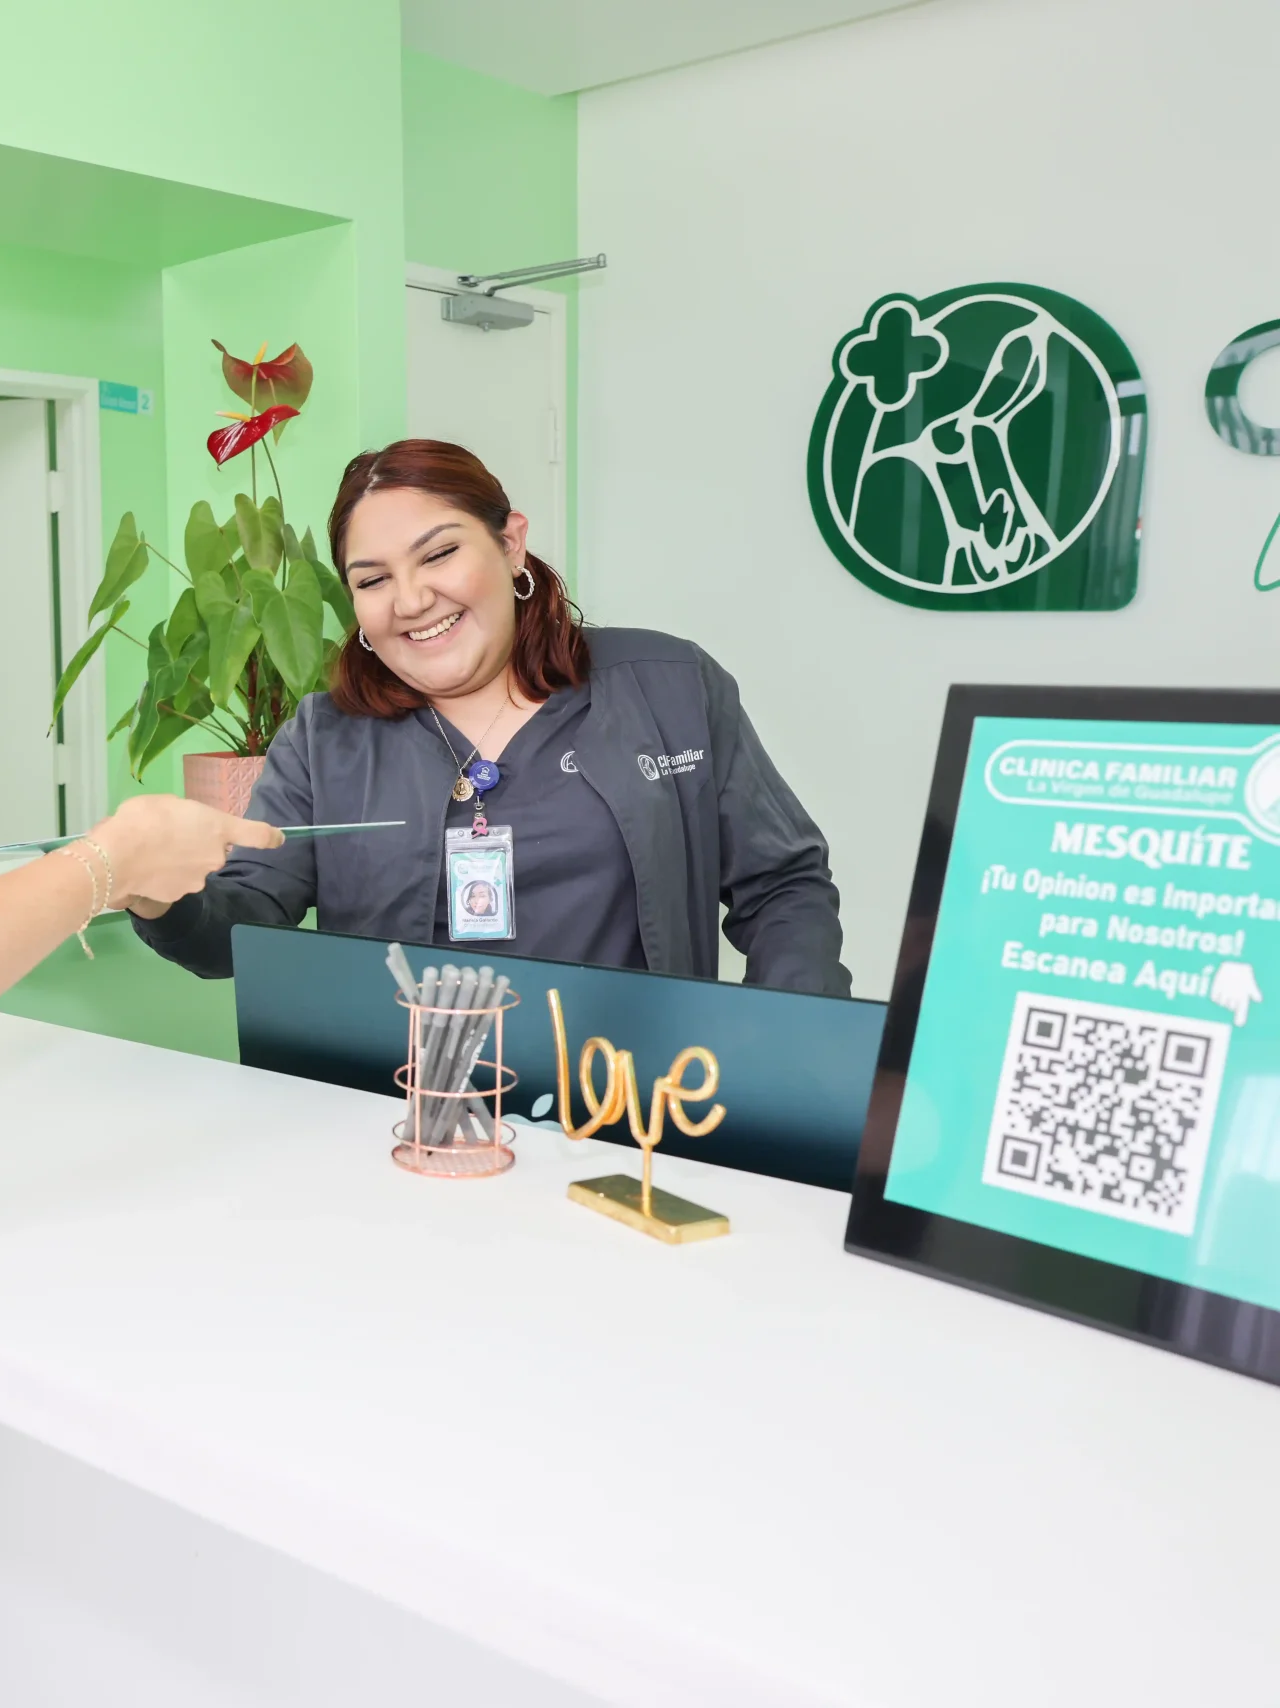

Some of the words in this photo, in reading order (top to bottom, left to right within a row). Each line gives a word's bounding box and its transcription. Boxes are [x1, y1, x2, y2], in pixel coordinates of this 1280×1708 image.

[141, 393, 150, 410] 2
[999, 756, 1100, 781] CLINICA
[1105, 761, 1238, 789] FAMILIAR
[1026, 778, 1047, 793] La
[1051, 779, 1104, 799] Virgen
[1108, 783, 1131, 798] de
[1133, 785, 1234, 808] Guadalupe
[981, 864, 1017, 894] ¡Tu
[1023, 868, 1117, 901] Opinion
[1124, 884, 1157, 906] es
[1163, 882, 1280, 921] Importa
[1039, 913, 1098, 938] para
[1107, 914, 1245, 957] Nosotros!
[1001, 940, 1127, 985] Escanea
[1133, 959, 1215, 1000] Aquí
